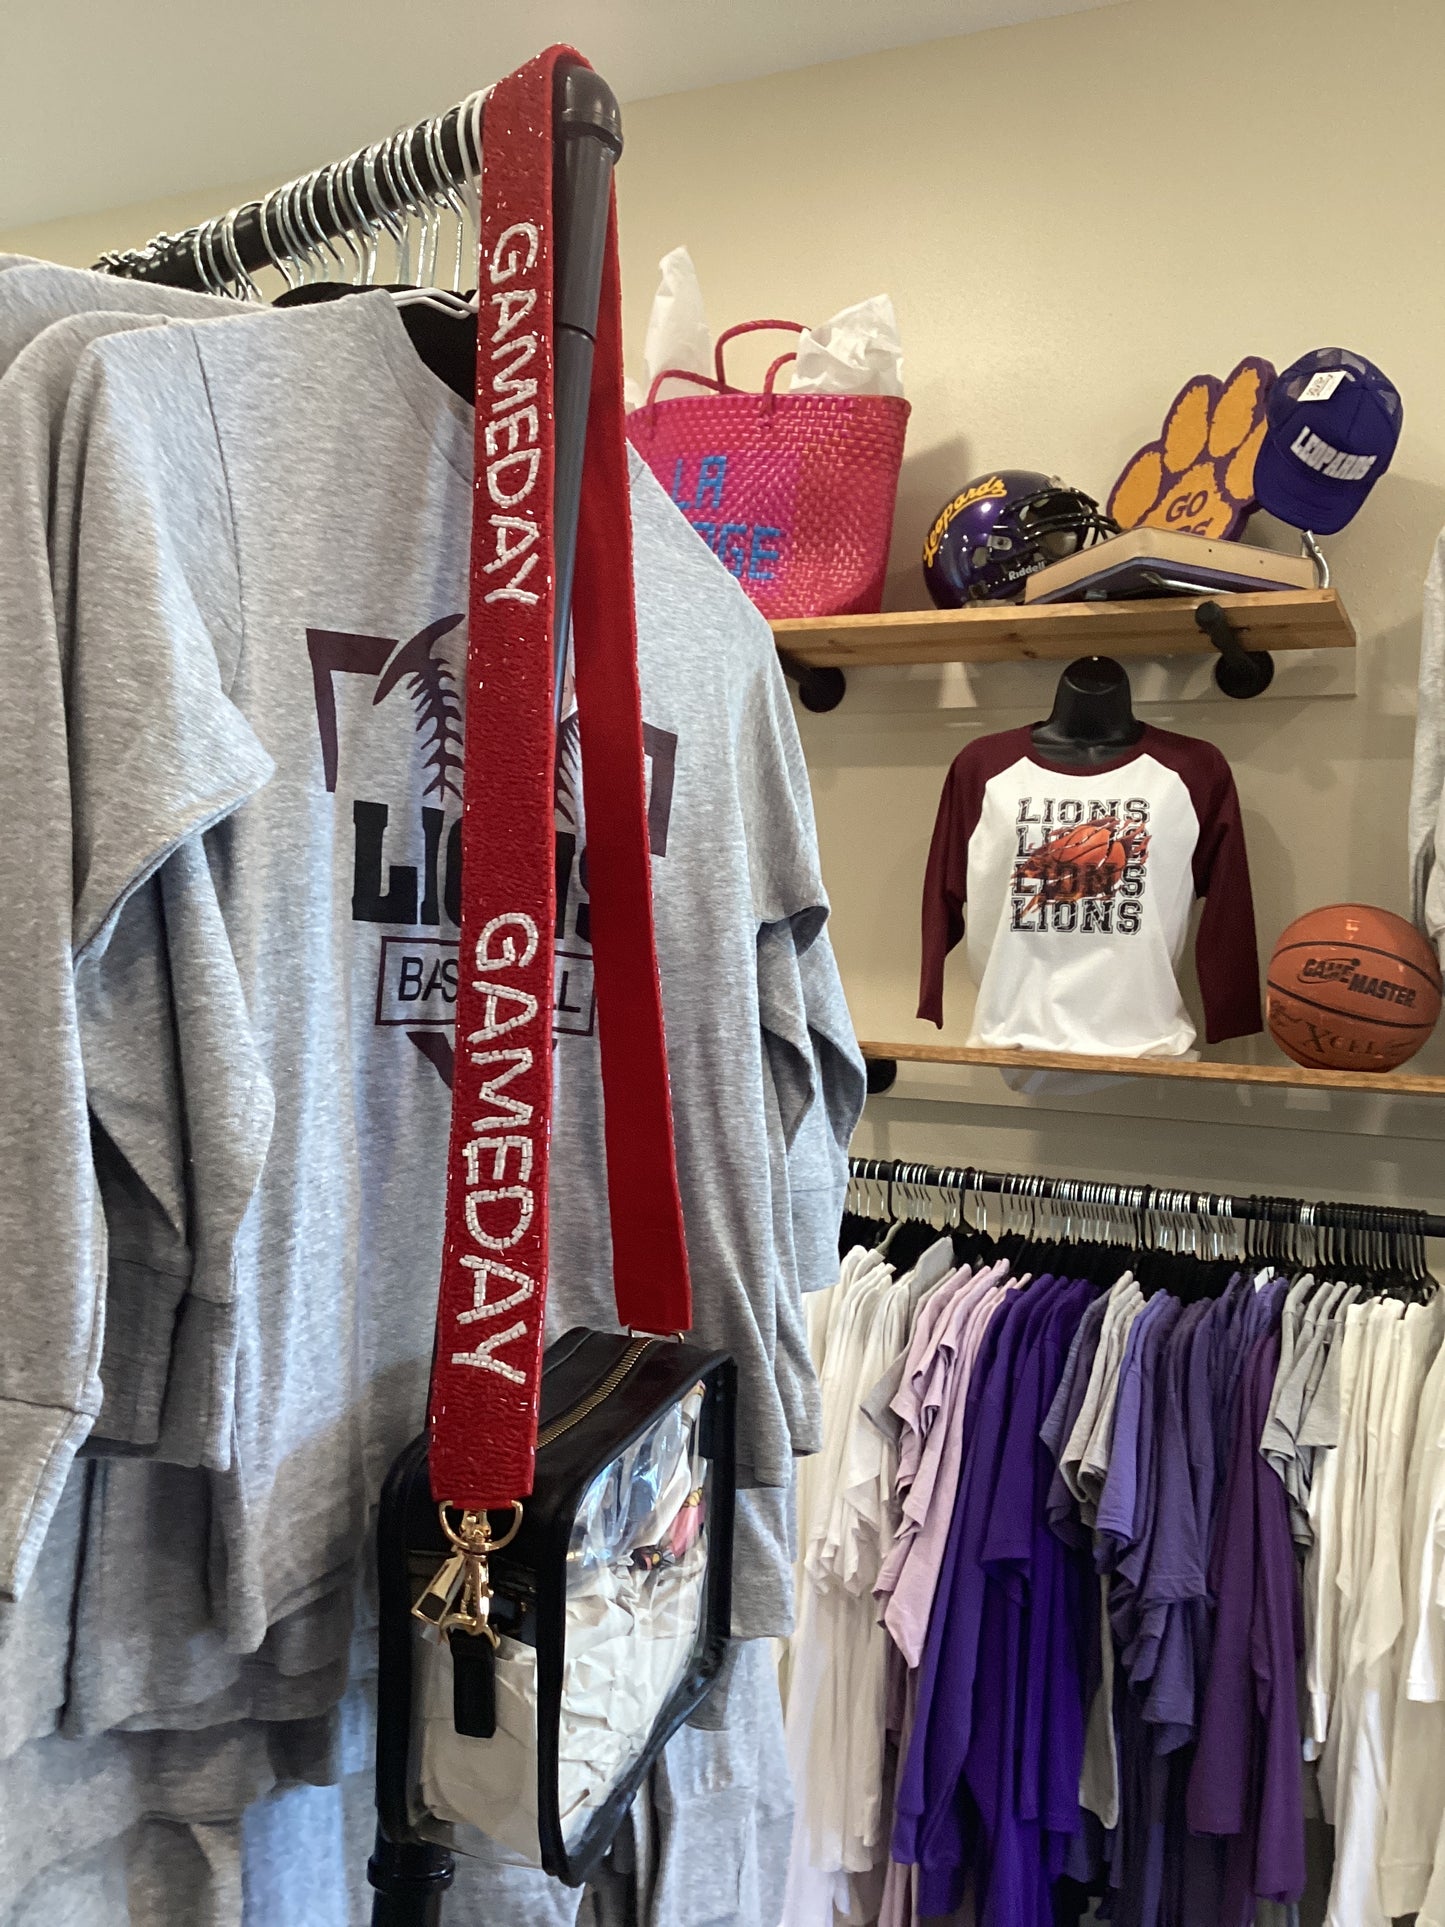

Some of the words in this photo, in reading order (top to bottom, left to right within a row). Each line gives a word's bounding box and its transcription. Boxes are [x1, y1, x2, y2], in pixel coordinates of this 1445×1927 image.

[483, 222, 541, 605] GAMEDAY
[1290, 425, 1377, 480] LEOPARDS
[671, 455, 727, 511] LA
[1165, 489, 1208, 522] GO
[923, 476, 1007, 568] Leopards
[1008, 561, 1046, 580] Riddell
[1016, 797, 1150, 824] LIONS
[1011, 897, 1143, 935] LIONS
[1302, 957, 1356, 984] GAME
[1347, 973, 1416, 1009] MASTER
[451, 912, 538, 1385] GAMEDAY
